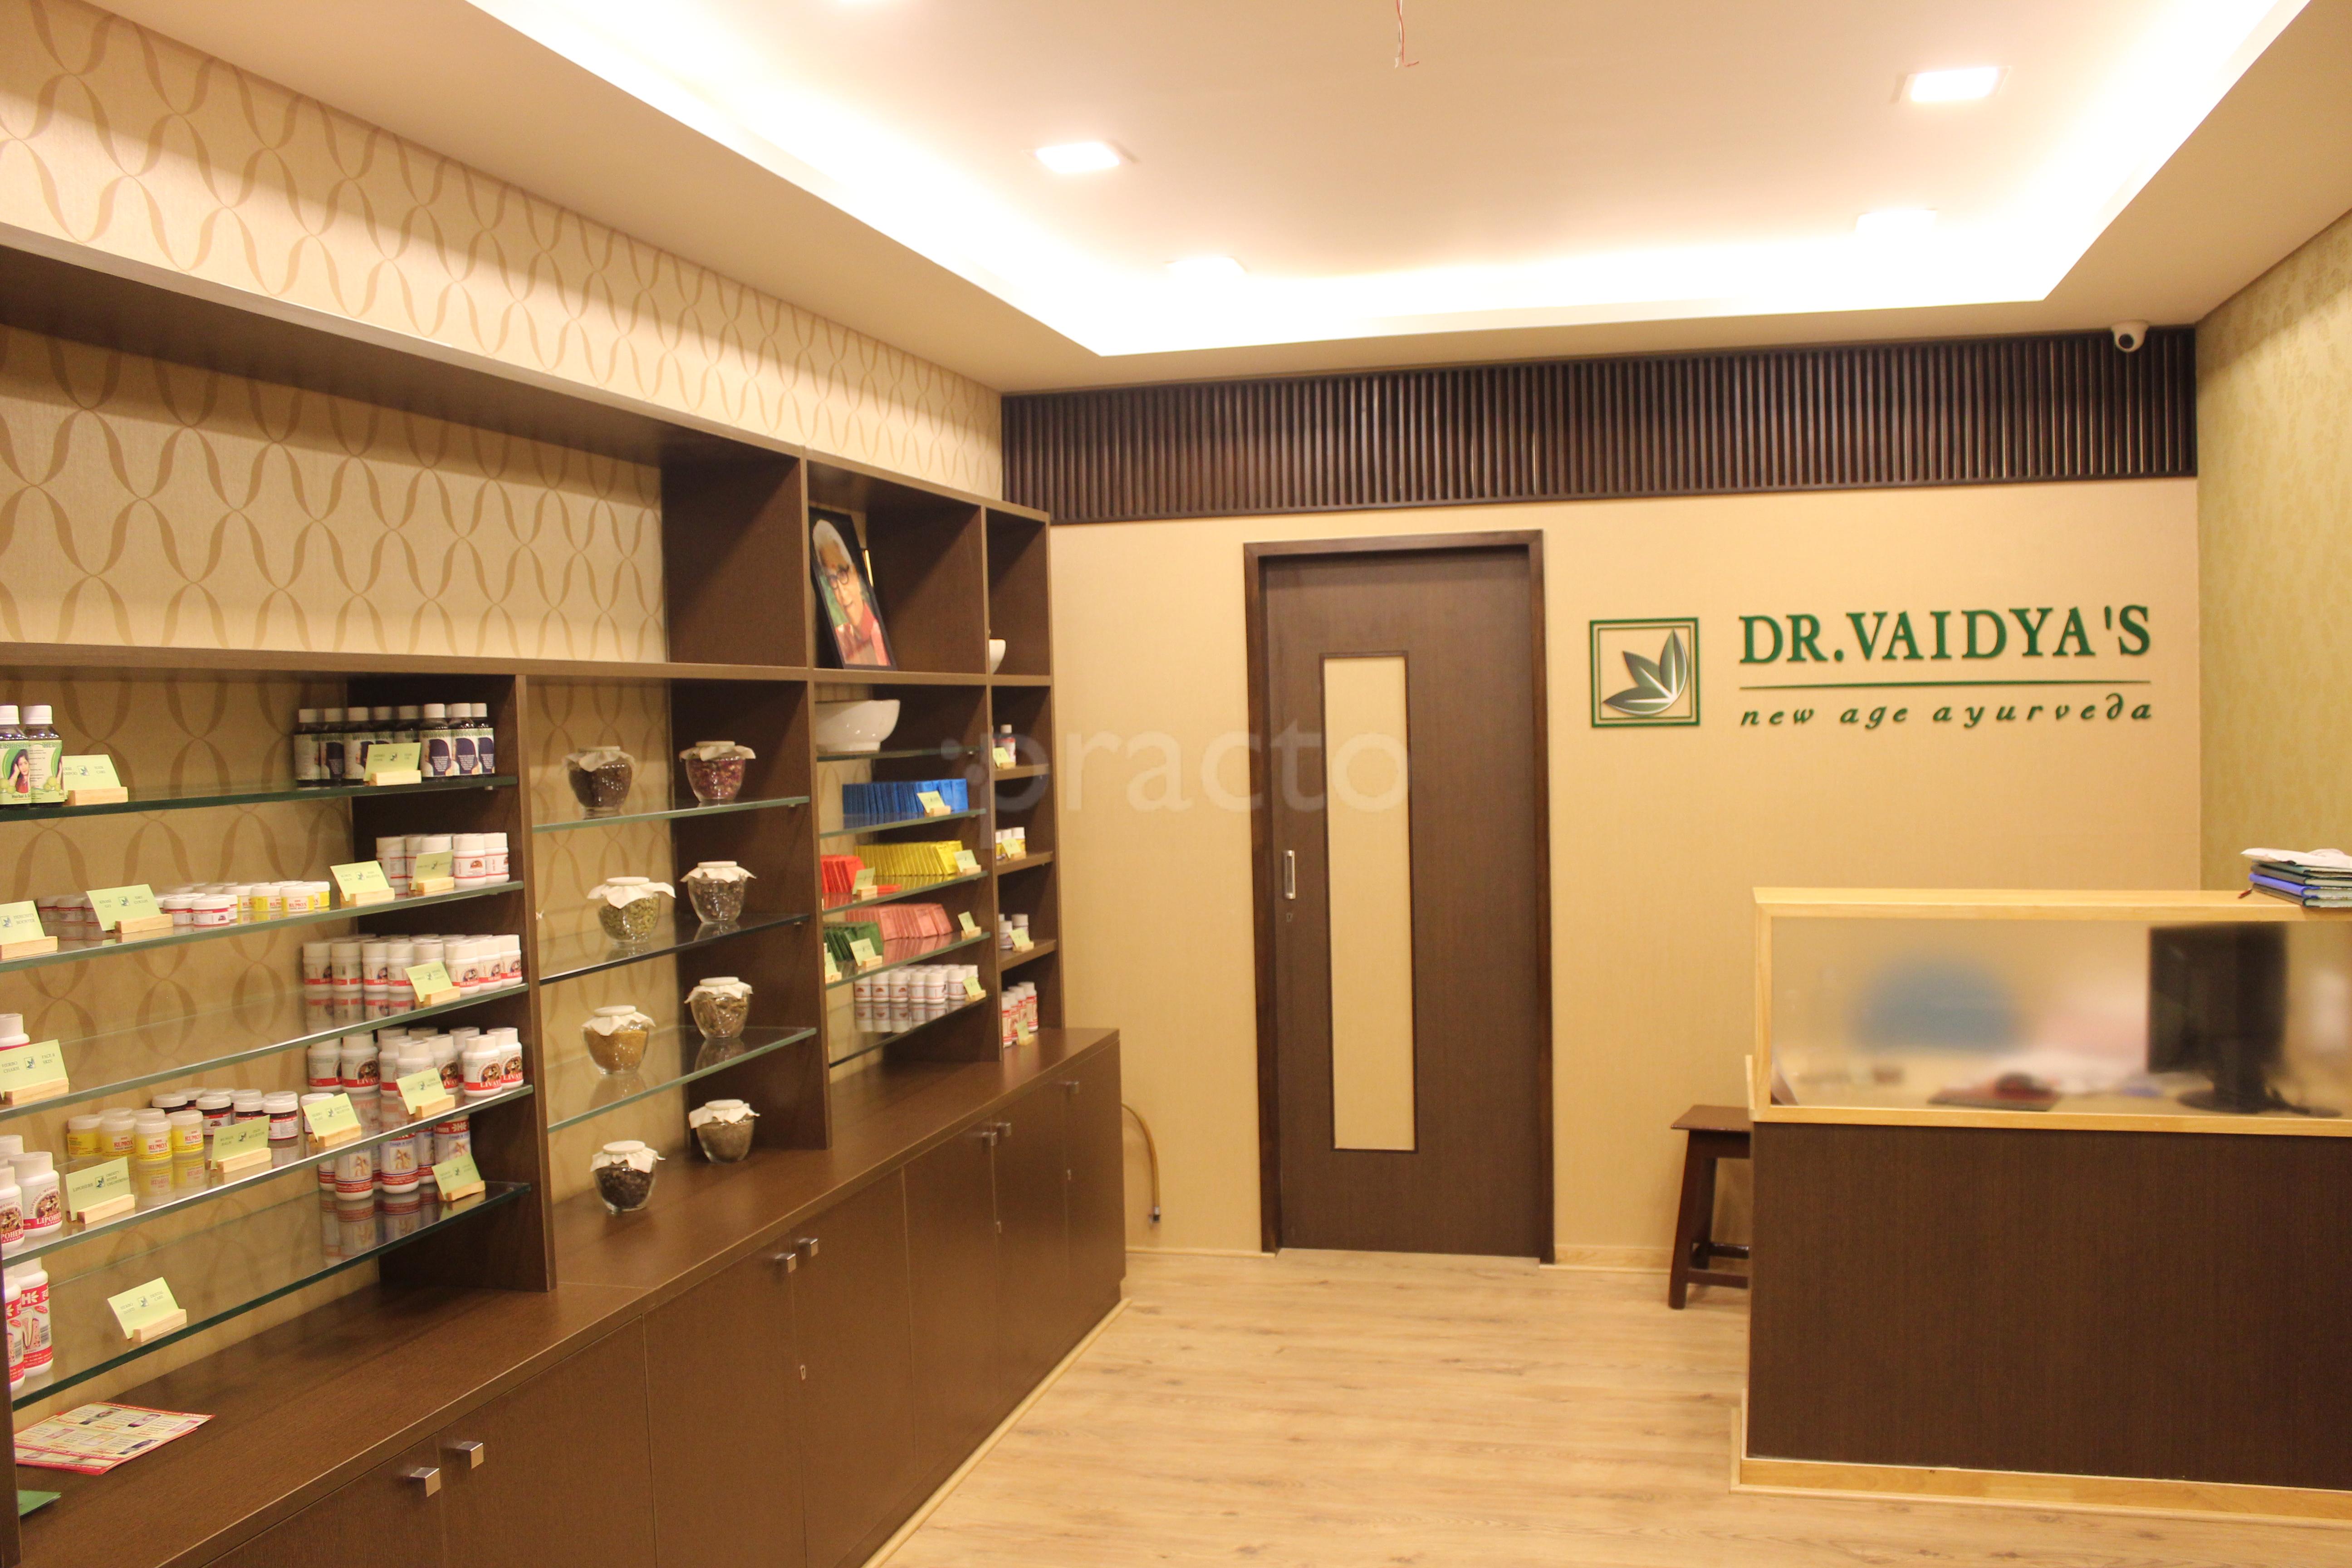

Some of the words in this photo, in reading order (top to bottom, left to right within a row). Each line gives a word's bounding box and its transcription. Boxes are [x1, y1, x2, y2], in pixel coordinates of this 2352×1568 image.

[1739, 605, 2150, 664] DR.VAIDYA'S
[1741, 708, 1814, 726] new
[1840, 706, 1908, 730] age
[1933, 692, 2151, 729] ayurveda
[149, 1142, 168, 1151] RUMOX
[37, 1212, 61, 1225] LIPOHE
